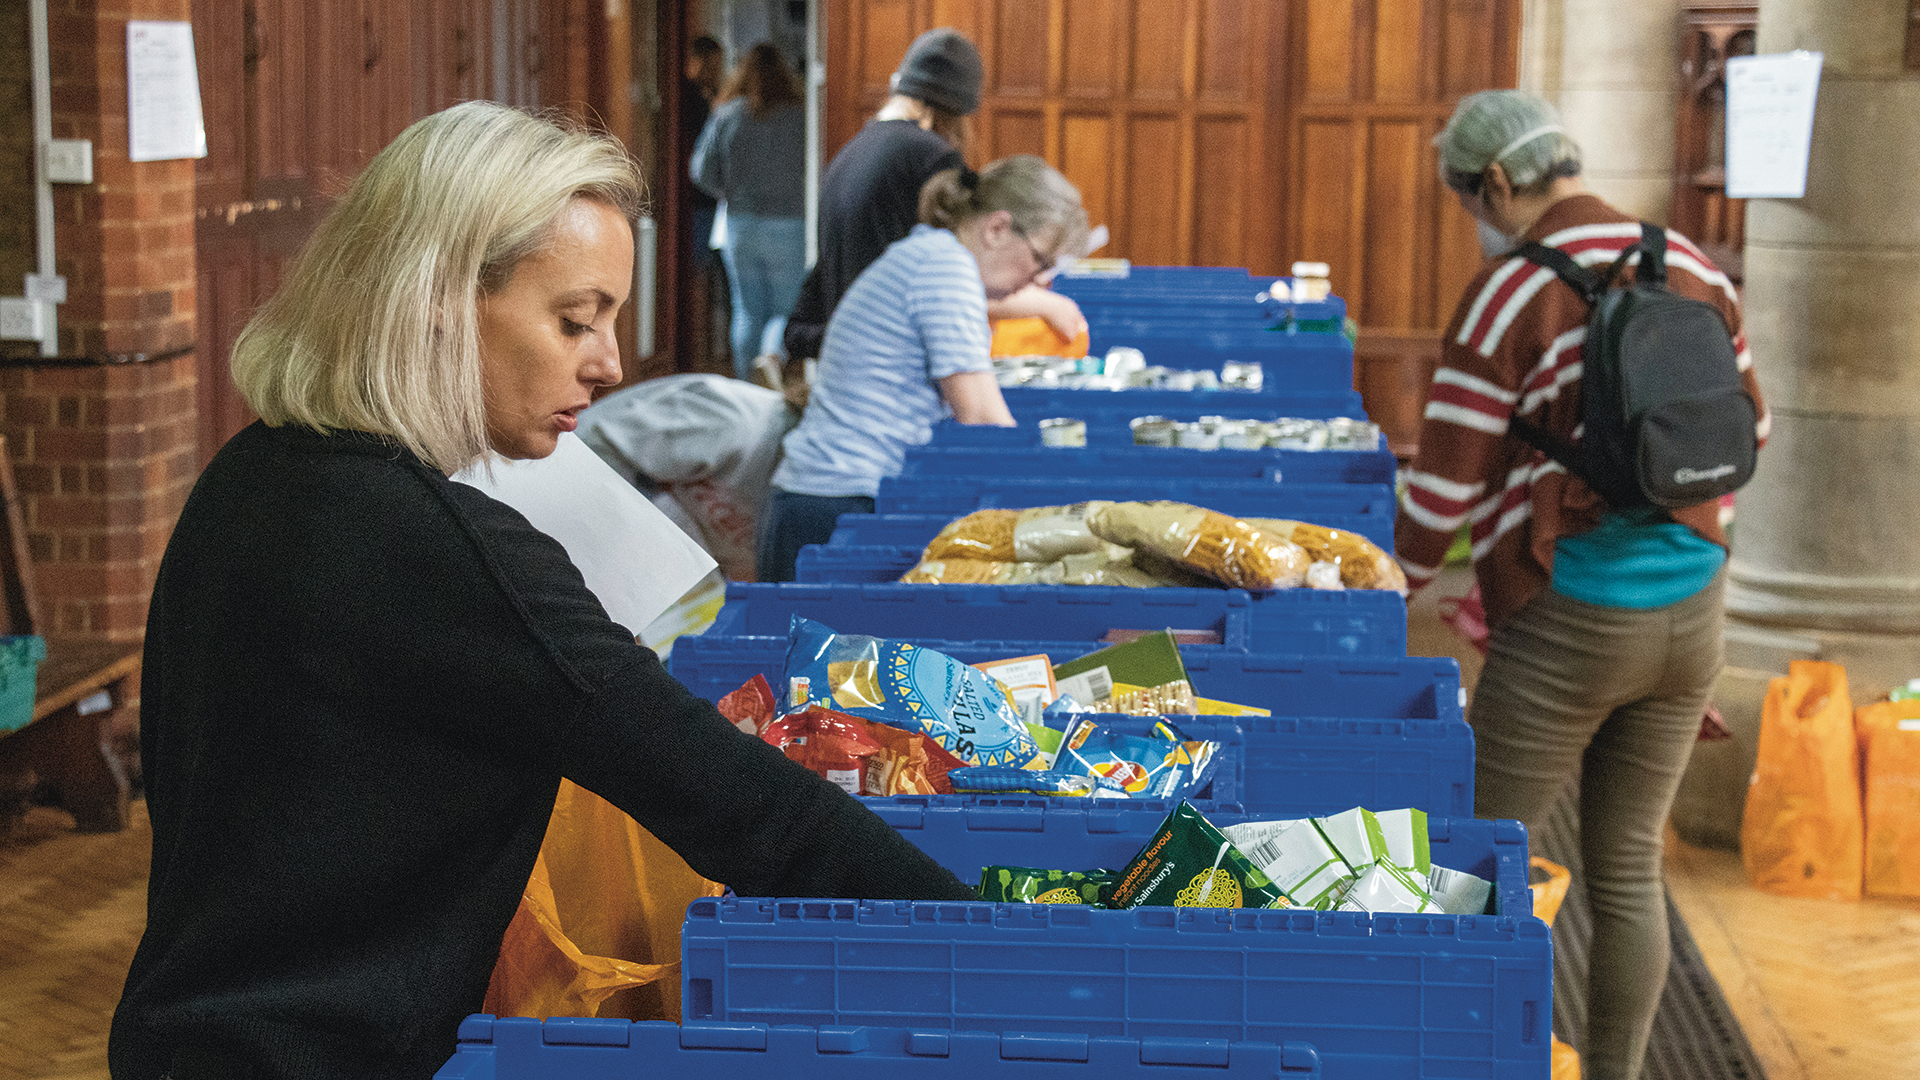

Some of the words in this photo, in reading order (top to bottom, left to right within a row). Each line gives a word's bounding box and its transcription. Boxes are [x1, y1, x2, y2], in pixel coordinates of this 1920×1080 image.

[963, 680, 985, 720] SALTED
[1111, 859, 1148, 901] vegetable
[1146, 830, 1173, 860] flavour
[1117, 884, 1138, 907] instant
[1136, 857, 1161, 886] noodles
[1135, 861, 1175, 905] Sainsbury's
